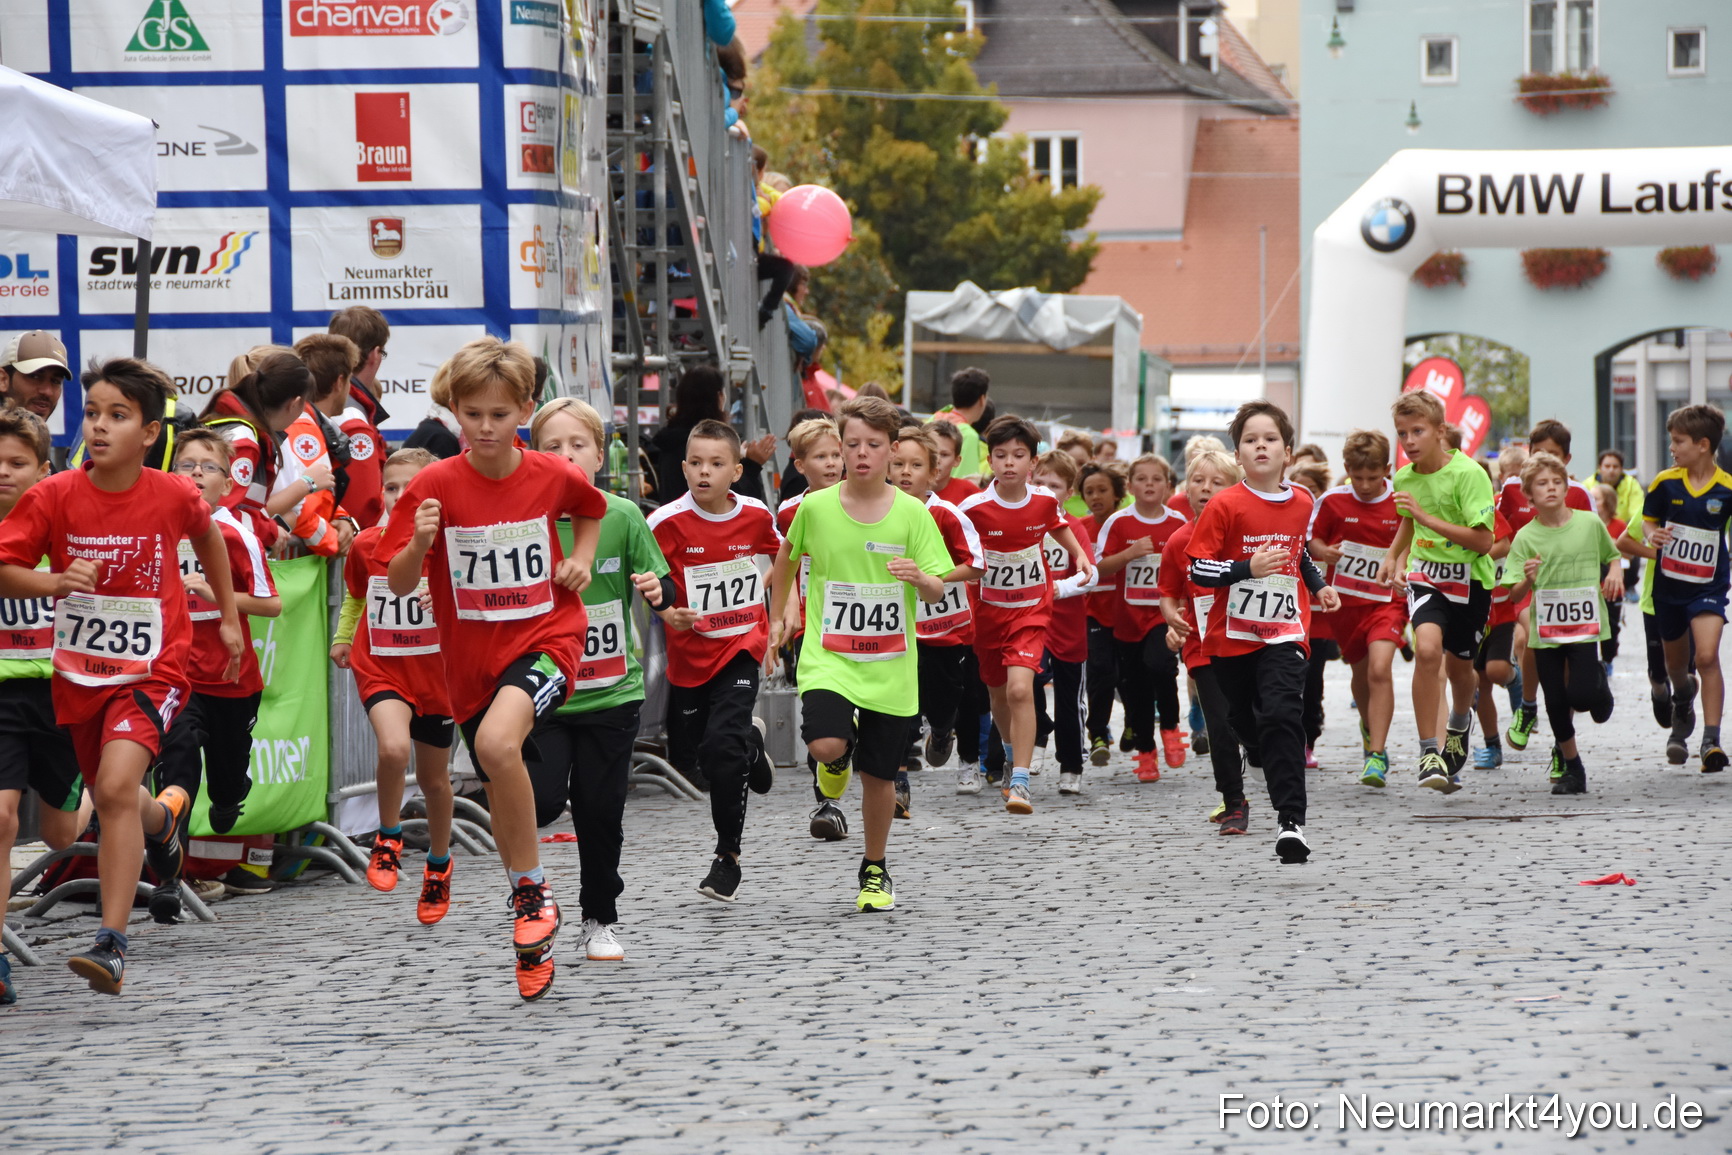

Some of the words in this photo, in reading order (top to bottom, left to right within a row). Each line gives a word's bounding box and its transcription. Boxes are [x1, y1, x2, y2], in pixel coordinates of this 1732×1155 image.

[297, 0, 420, 27] charivari
[355, 141, 408, 166] Braun
[1436, 173, 1584, 216] BMW
[88, 245, 201, 277] swn
[344, 264, 433, 280] Neumarkter
[166, 277, 232, 290] neumarkt
[328, 280, 449, 300] Lammsbräu
[66, 533, 134, 545] Neumarkter
[492, 522, 542, 541] BOCK
[1243, 532, 1291, 544] Neumarkter
[66, 546, 120, 561] Stadtlauf
[686, 546, 705, 554] JAKO
[1669, 537, 1715, 563] 7000
[151, 533, 163, 592] BAMBINI
[459, 543, 543, 584] 7116
[1343, 554, 1380, 580] 720
[988, 561, 1041, 587] 7214
[484, 592, 528, 608] Moritz
[695, 573, 757, 612] 7127
[861, 586, 900, 597] BOCK
[1005, 591, 1024, 601] Luis
[63, 600, 96, 612] NeuerMarkt
[102, 599, 153, 614] BOCK
[373, 595, 436, 626] 710
[586, 604, 616, 618] OCK
[1238, 587, 1297, 620] 7179
[1542, 600, 1595, 623] 7059
[709, 611, 754, 629] Shkelzen
[832, 601, 900, 632] 7043
[65, 613, 152, 657] 7235
[921, 619, 954, 633] Fabian
[1250, 623, 1280, 637] Quirin
[11, 632, 36, 647] Max
[392, 633, 422, 645] Marc
[584, 622, 618, 657] 69
[851, 638, 879, 652] Leon
[84, 658, 124, 676] Lukas
